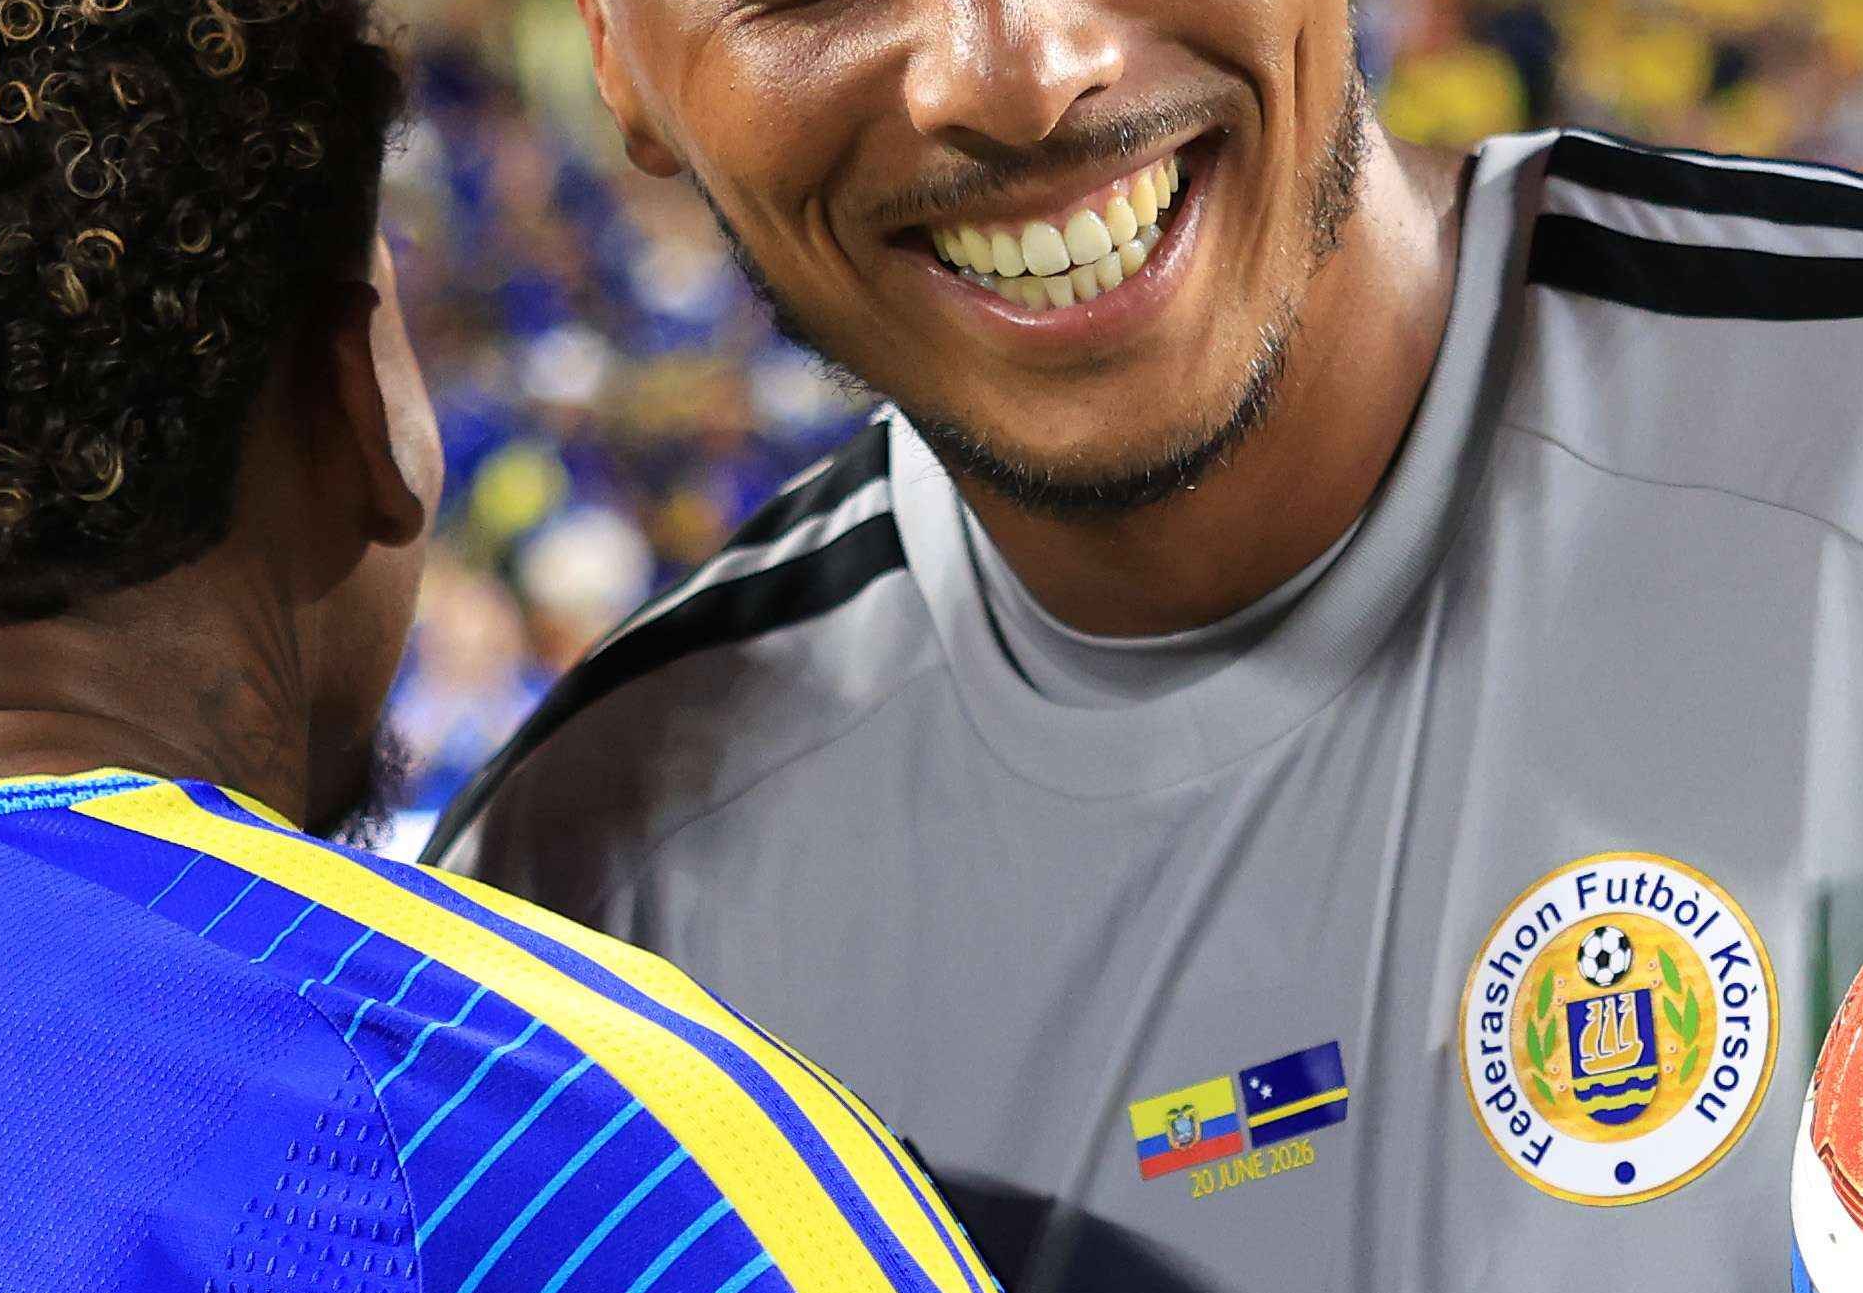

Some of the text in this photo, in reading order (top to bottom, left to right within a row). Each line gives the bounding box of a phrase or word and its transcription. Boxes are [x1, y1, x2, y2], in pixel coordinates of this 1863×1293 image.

[1480, 873, 1759, 1168] Federashon Futbòl Kòrsou
[1191, 1138, 1317, 1199] 20 JUNE 2026
